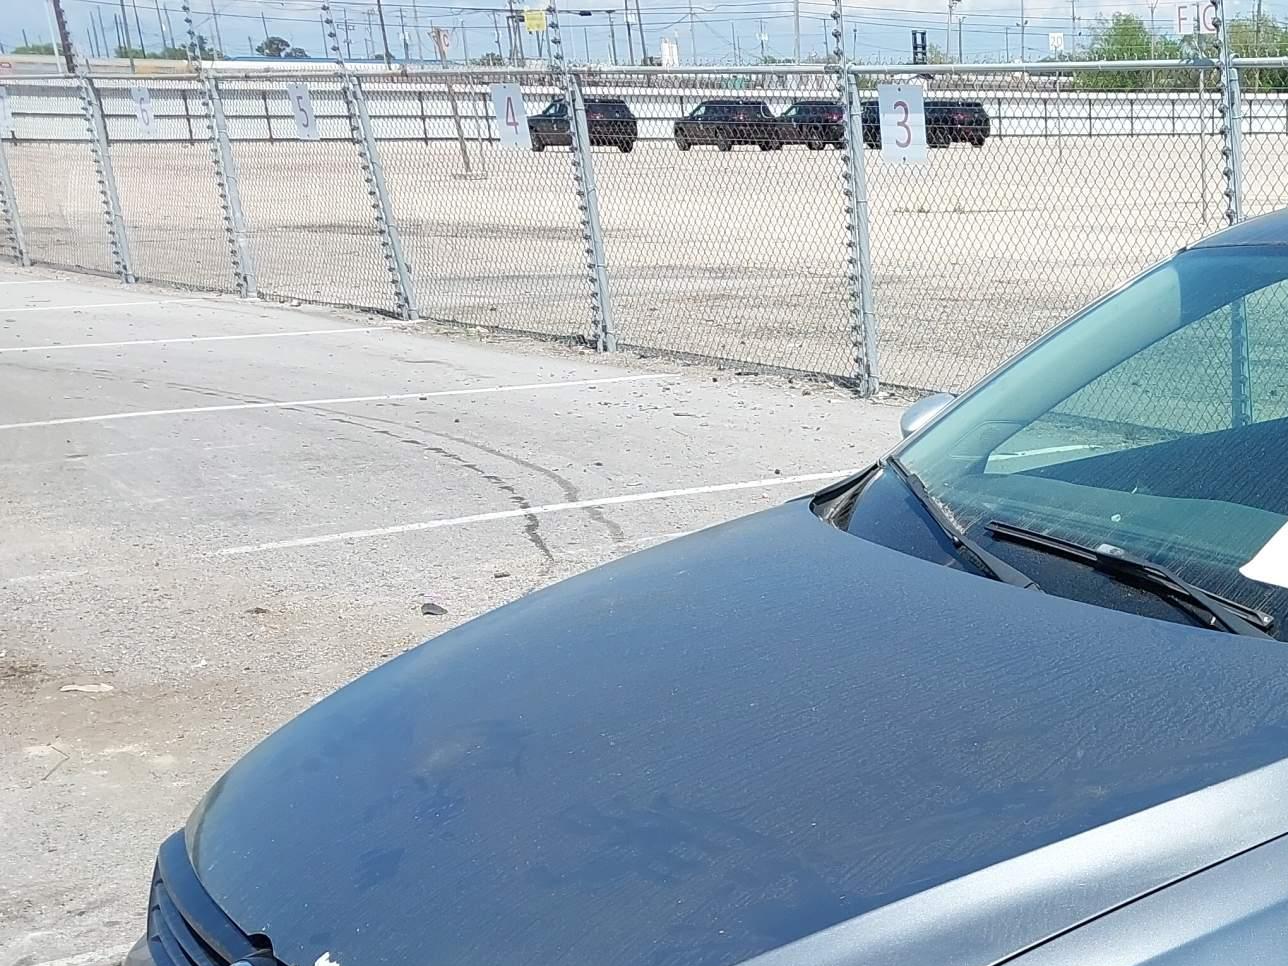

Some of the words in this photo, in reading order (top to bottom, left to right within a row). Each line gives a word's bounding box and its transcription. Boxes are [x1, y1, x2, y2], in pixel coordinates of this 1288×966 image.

[1178, 5, 1188, 33] F
[140, 96, 150, 126] 6
[296, 95, 309, 128] 5
[506, 96, 519, 135] 4
[893, 100, 912, 148] 3
